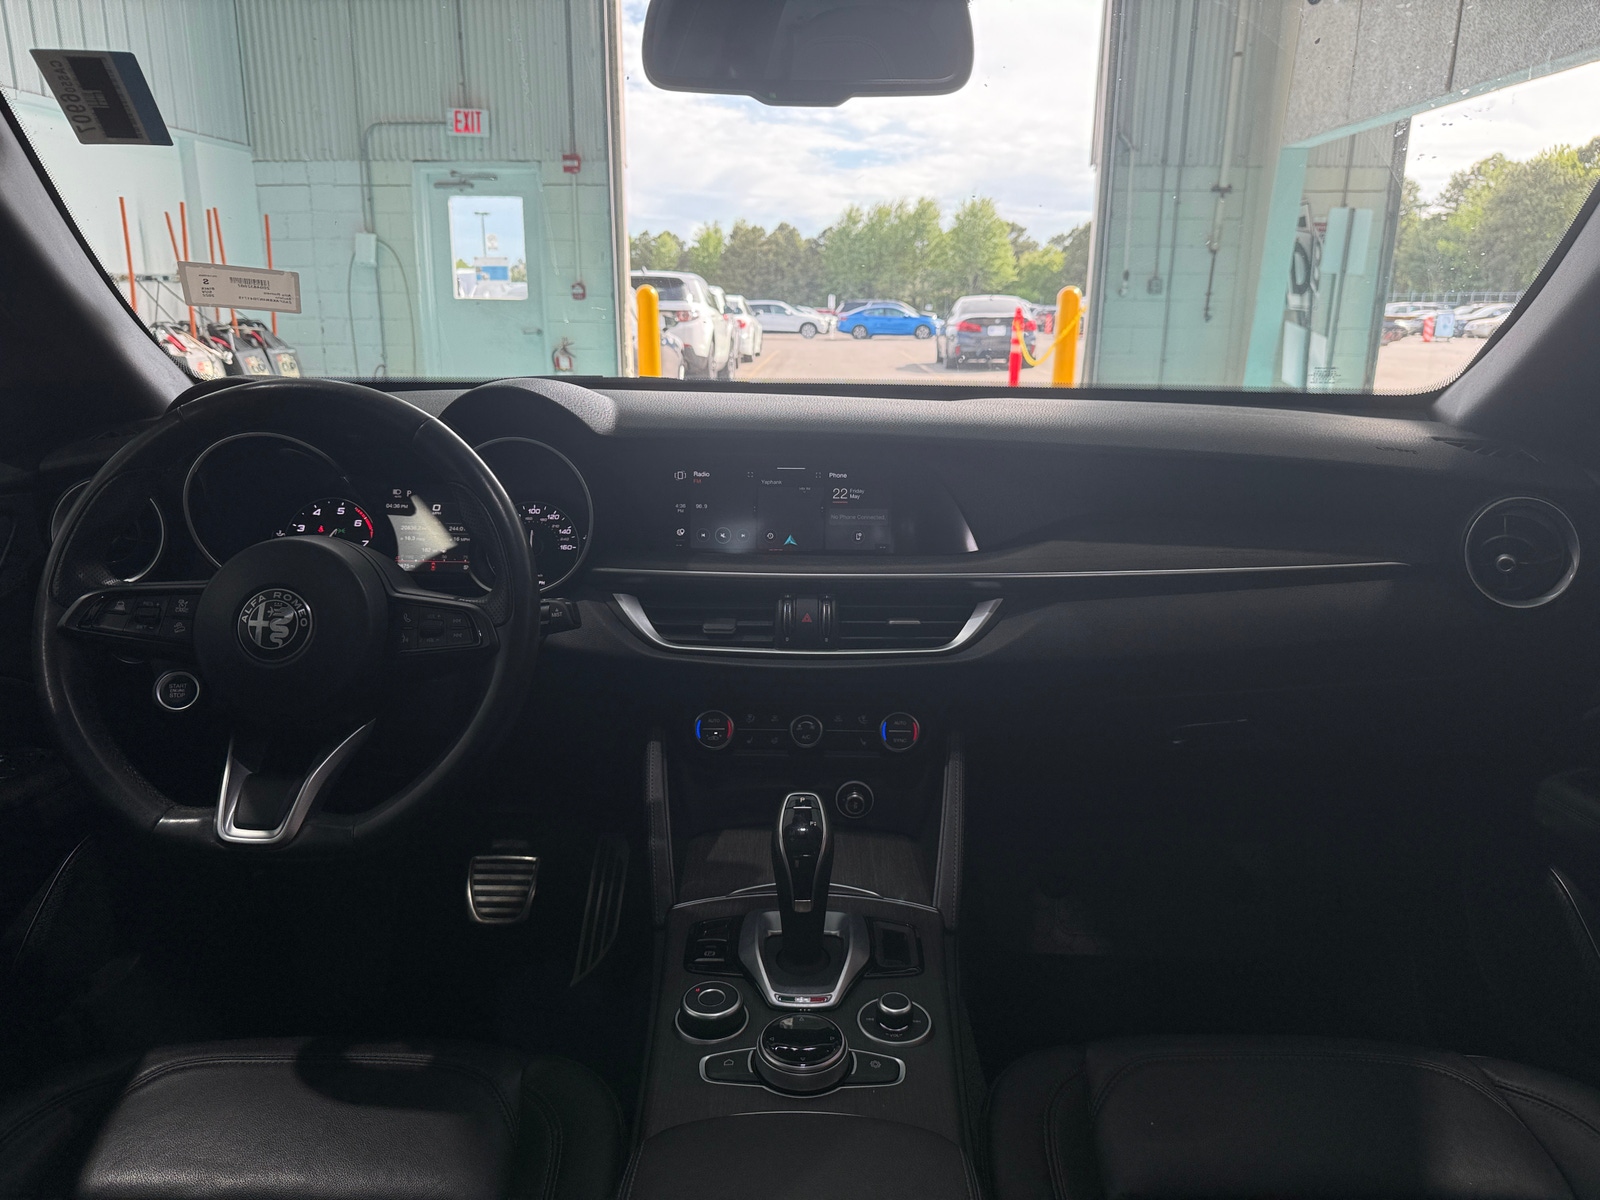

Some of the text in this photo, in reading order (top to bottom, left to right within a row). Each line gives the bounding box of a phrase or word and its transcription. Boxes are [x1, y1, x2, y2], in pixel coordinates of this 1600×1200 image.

[454, 109, 482, 134] EXIT
[832, 488, 848, 500] 22
[241, 591, 308, 627] ALFA ROMEO
